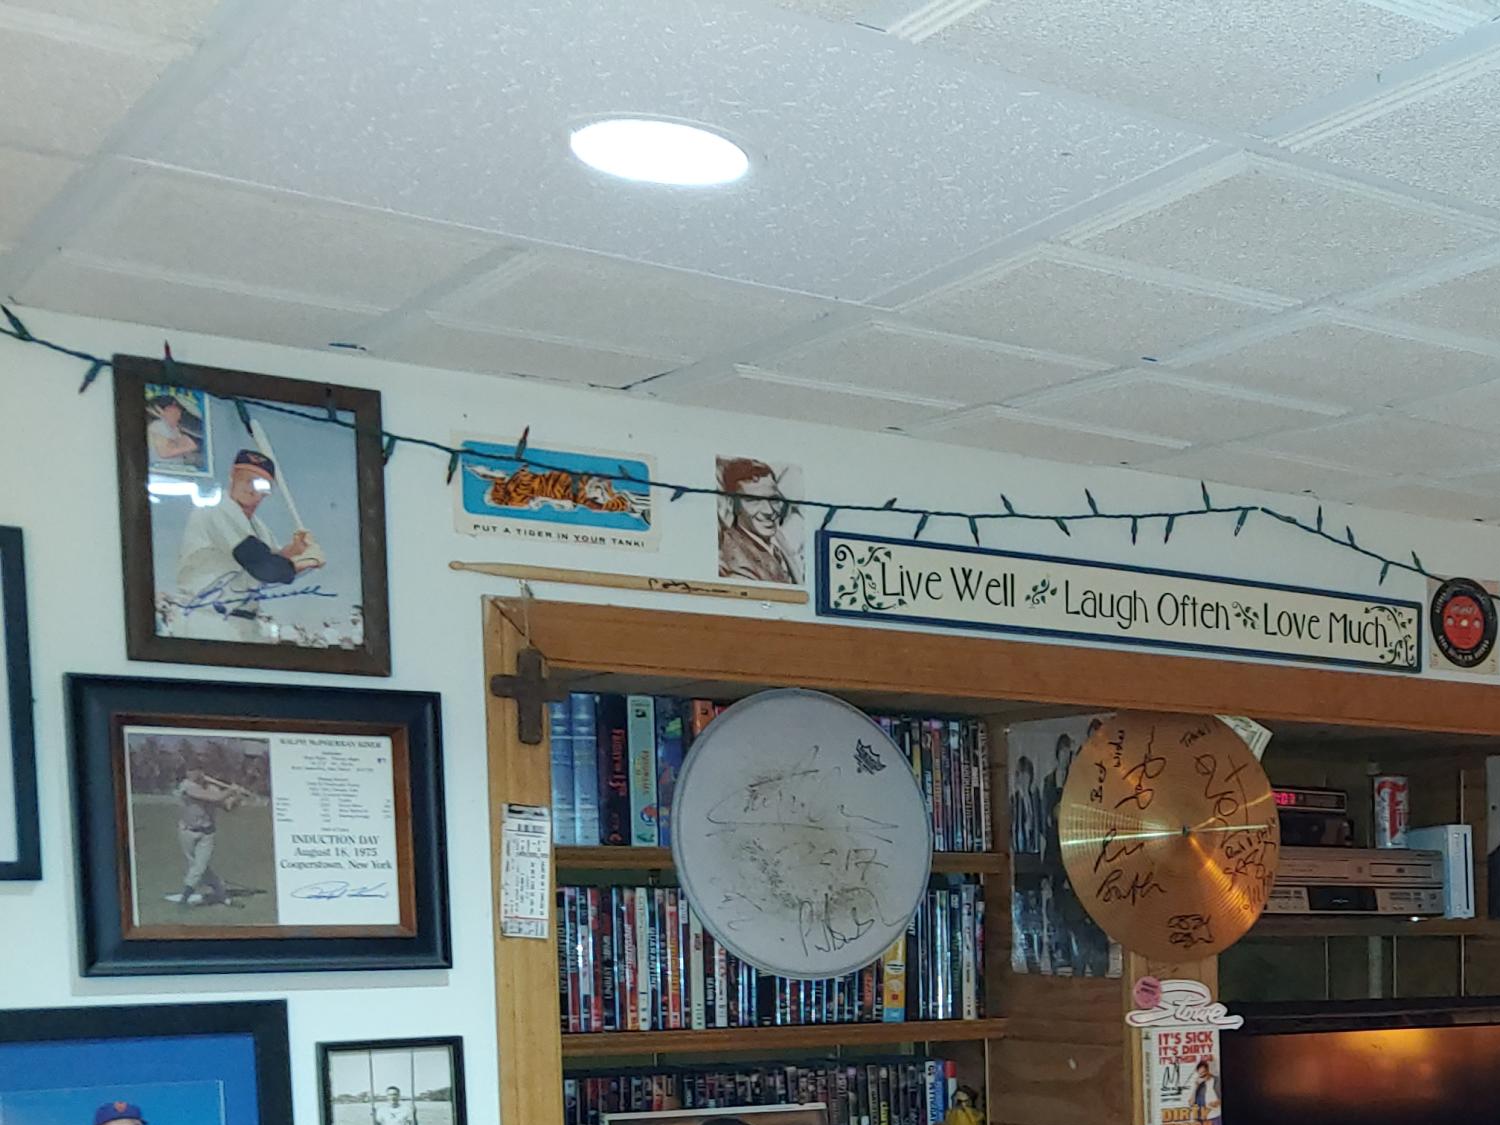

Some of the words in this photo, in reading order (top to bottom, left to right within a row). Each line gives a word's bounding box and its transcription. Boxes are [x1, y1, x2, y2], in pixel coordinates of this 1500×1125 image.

[473, 524, 497, 534] PUT
[516, 527, 553, 539] TIGER
[557, 533, 569, 541] IN
[573, 535, 606, 545] YOUR
[881, 560, 943, 601] Live
[950, 565, 1015, 608] Well
[1064, 579, 1149, 630] Laugh
[1156, 592, 1231, 631] Often
[1263, 602, 1321, 641] Love
[1327, 611, 1389, 648] Much
[291, 834, 356, 846] INDUCTION
[358, 835, 381, 846] DAY
[294, 847, 331, 858] August
[354, 848, 378, 857] 1975
[280, 860, 344, 871] Cooperstown,
[348, 860, 369, 870] New
[371, 860, 393, 870] York
[1158, 1032, 1181, 1046] IT'S
[1185, 1031, 1213, 1044] SICK
[1158, 1046, 1179, 1057] IT'S
[1182, 1044, 1214, 1055] DIRTY
